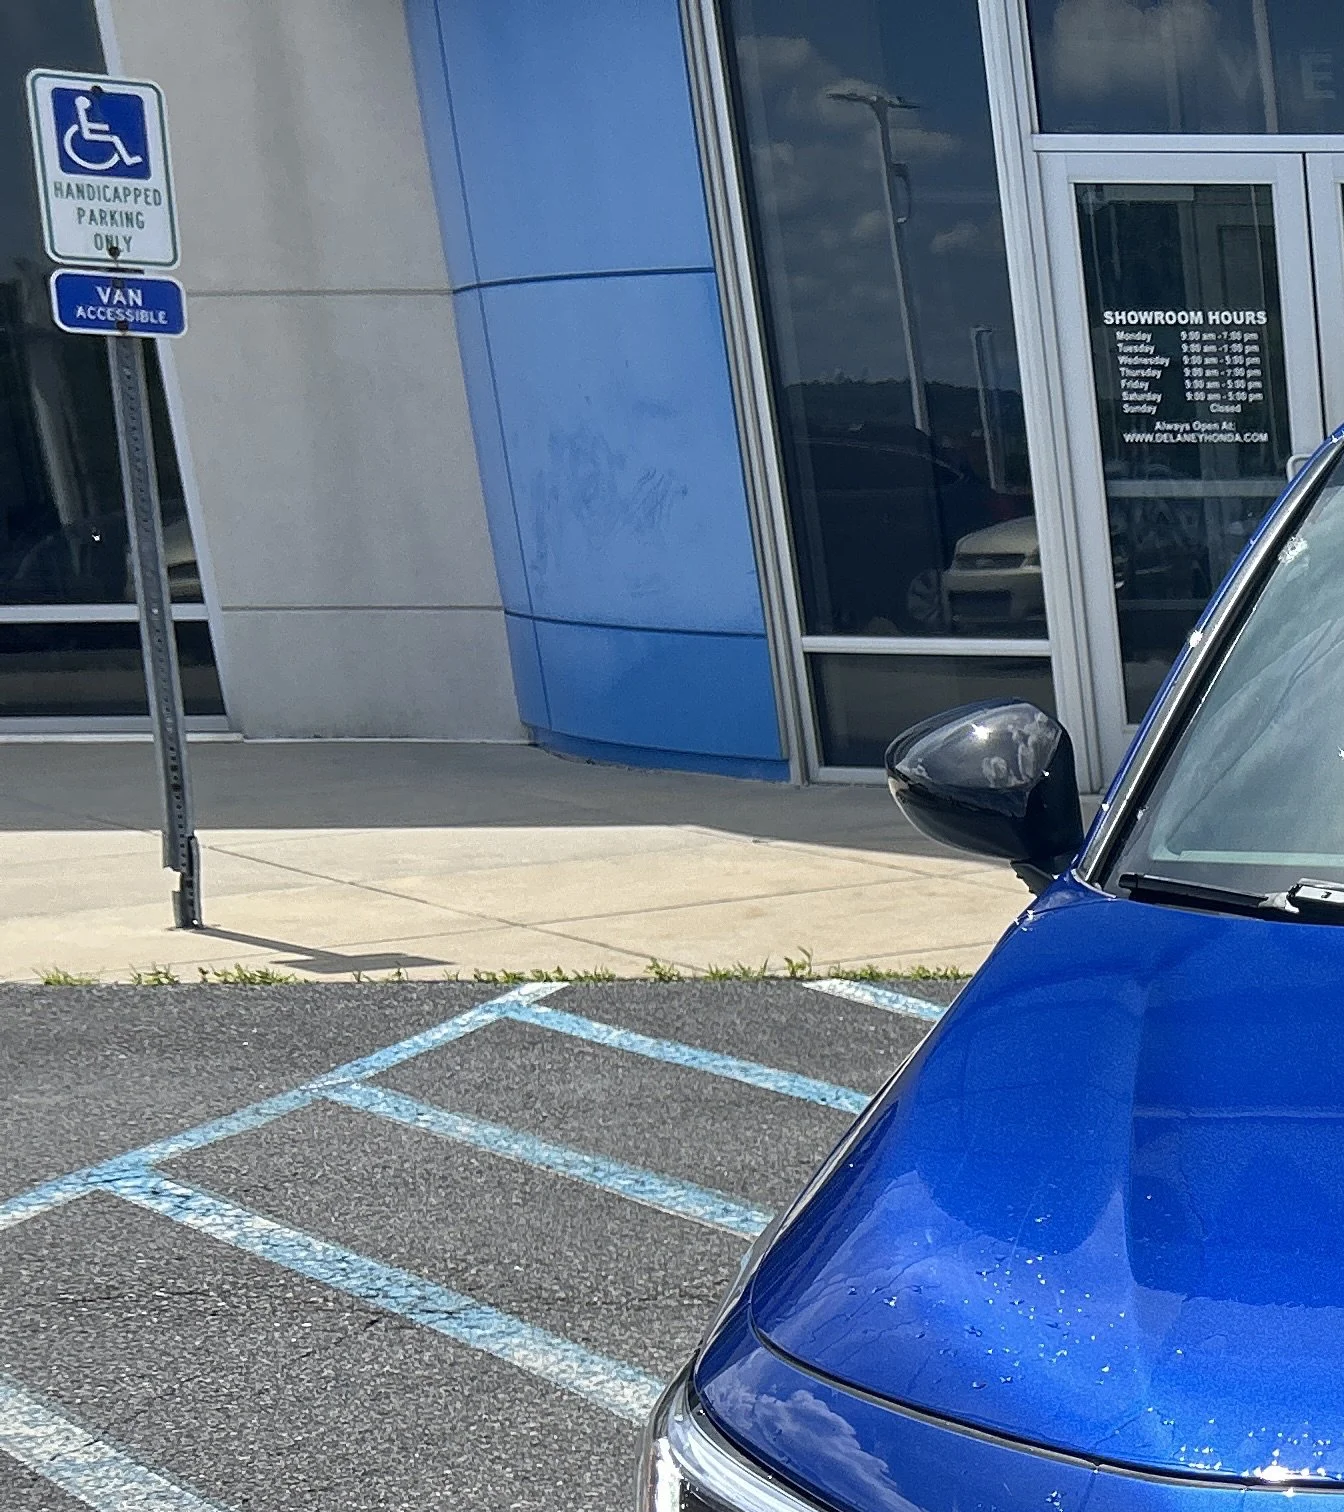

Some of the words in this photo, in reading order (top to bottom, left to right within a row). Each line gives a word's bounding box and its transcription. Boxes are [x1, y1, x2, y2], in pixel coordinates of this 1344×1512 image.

[53, 181, 162, 207] HANDICAPPED
[76, 207, 146, 229] PARKING
[93, 233, 133, 253] ONLY
[95, 286, 143, 306] VAN
[75, 305, 169, 325] ACCESSIBLE
[1103, 310, 1204, 325] SHOWROOM
[1207, 310, 1268, 325] HOURS
[1115, 331, 1152, 343] Monday
[1117, 343, 1155, 354] Tuesday
[1117, 355, 1170, 367] Wednesday
[1119, 367, 1162, 379] Thursday
[1120, 379, 1150, 391] Friday
[1121, 391, 1162, 403] Saturday
[1122, 403, 1158, 415] Sunday
[1209, 403, 1242, 413] Closed
[1154, 421, 1191, 433] Always
[1192, 420, 1220, 432] Open
[1122, 432, 1269, 443] WWW.DELANEYHONDA.COM
